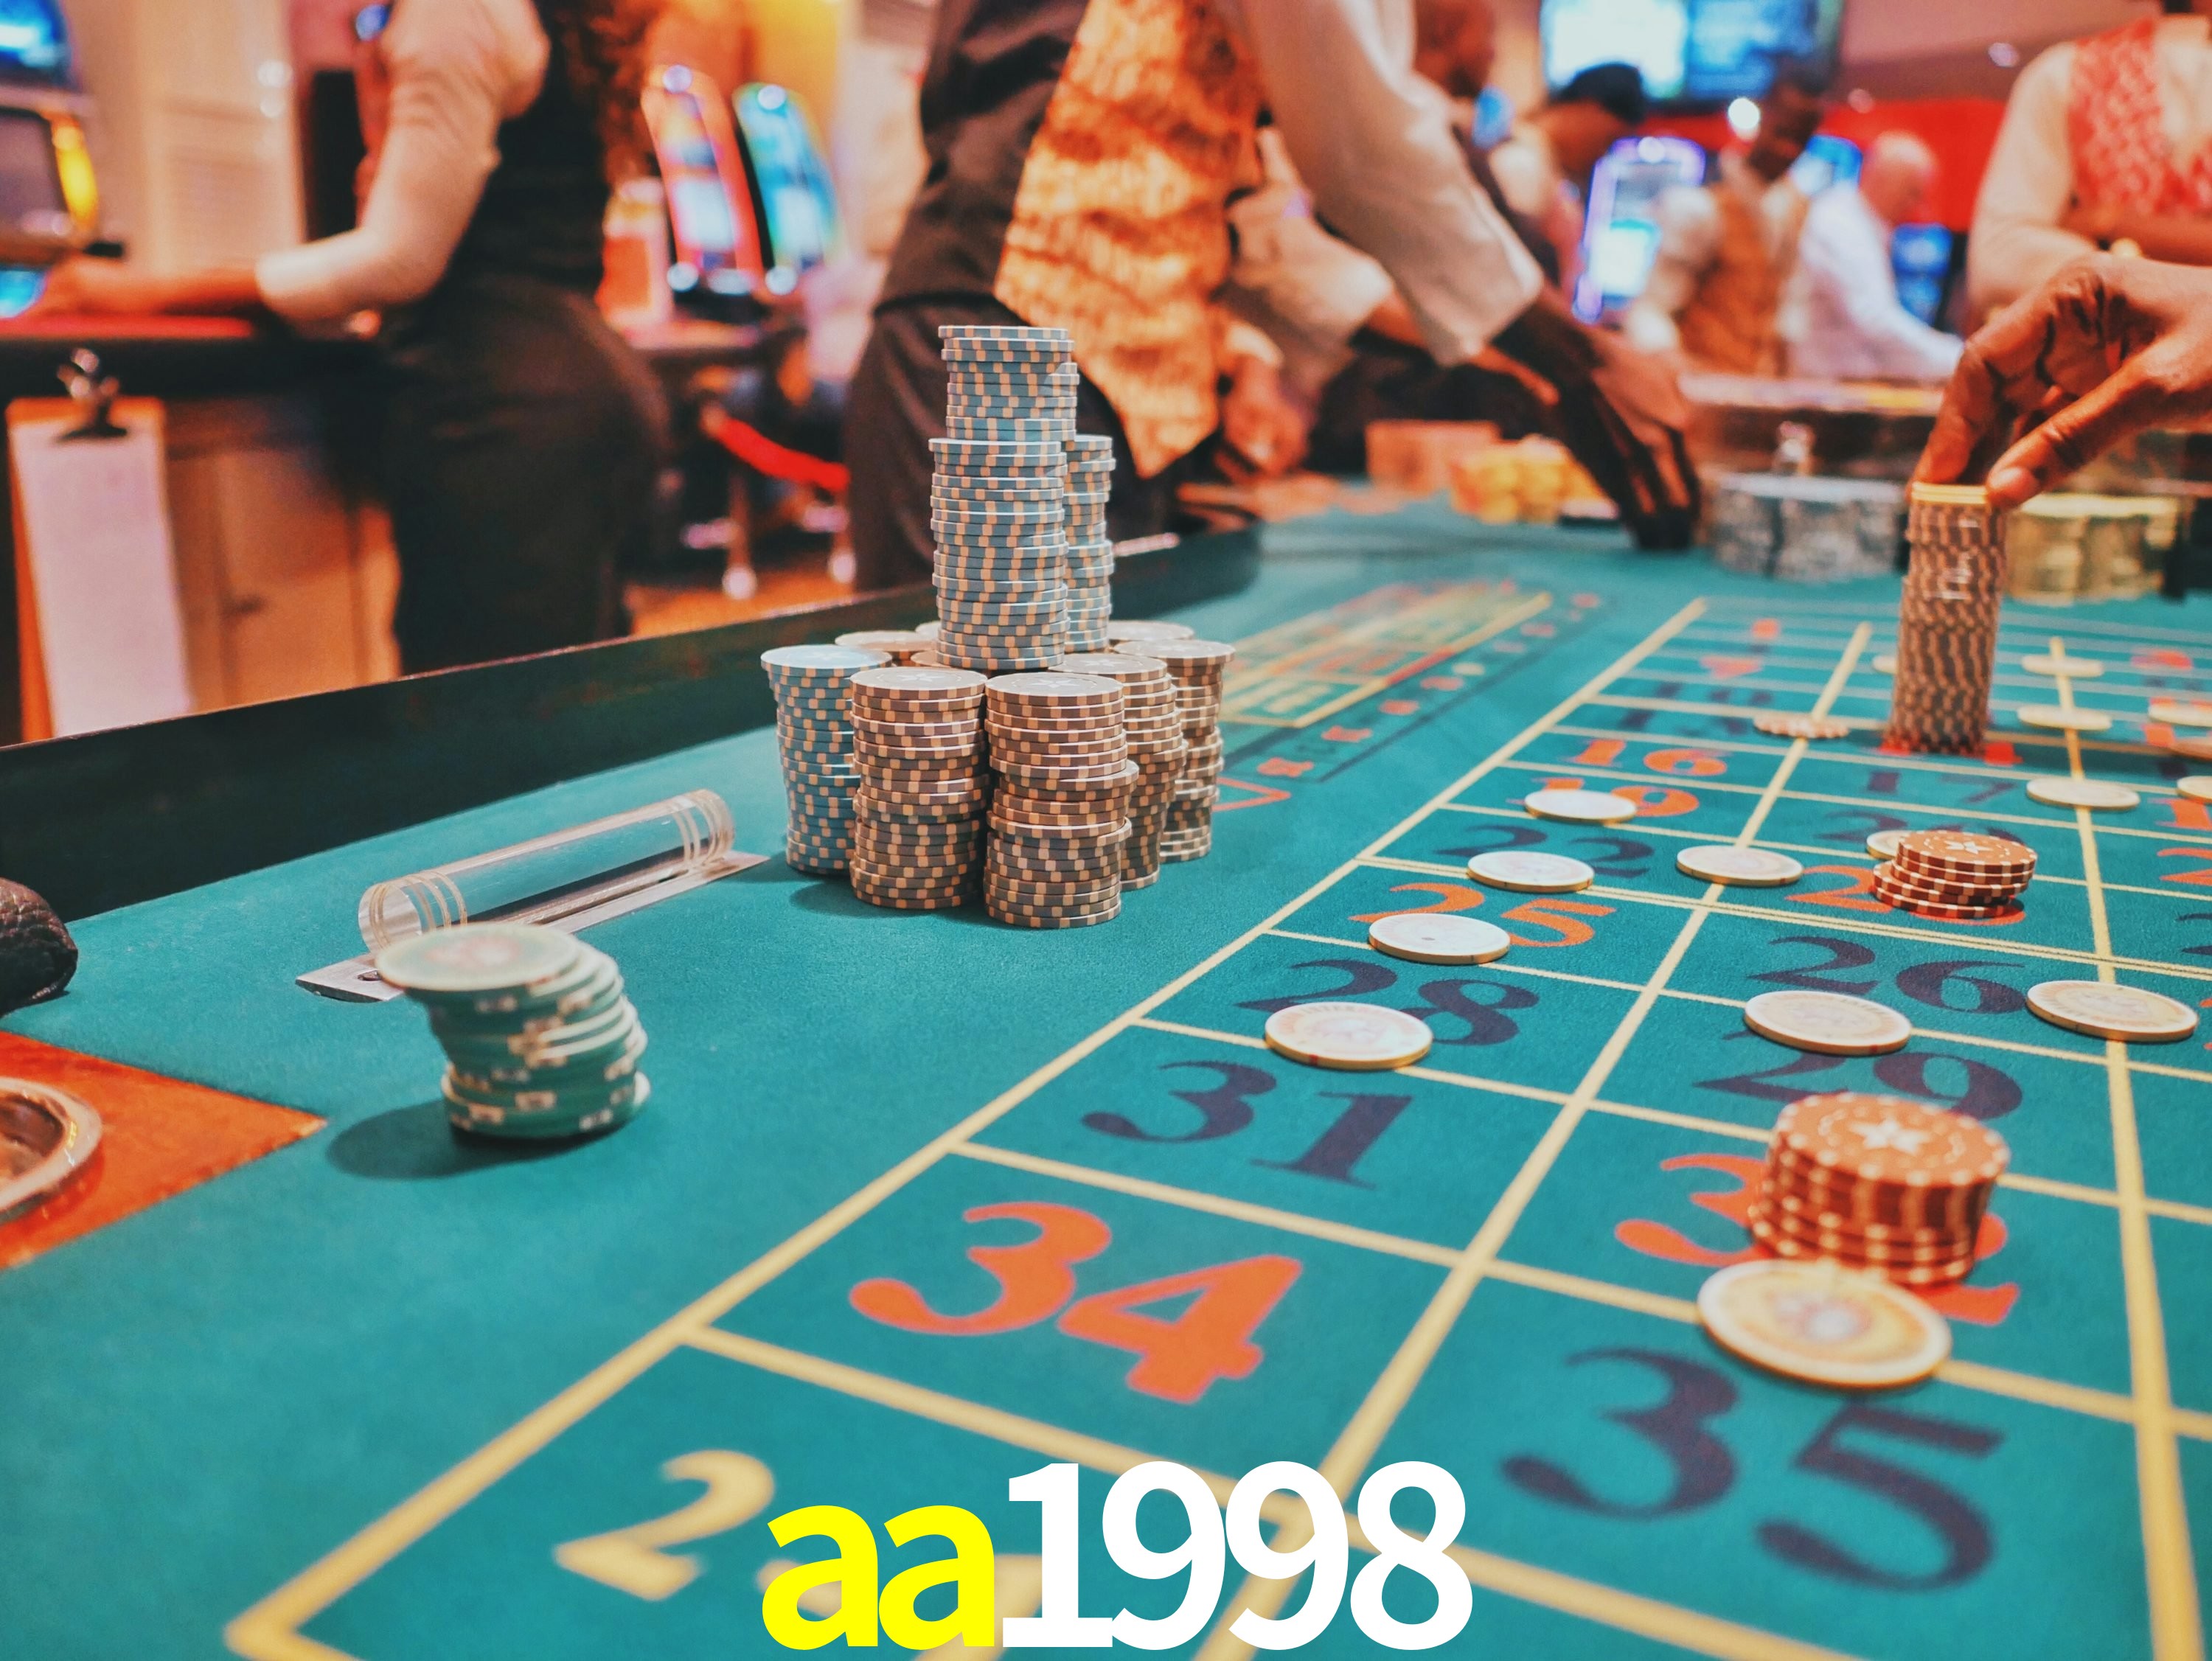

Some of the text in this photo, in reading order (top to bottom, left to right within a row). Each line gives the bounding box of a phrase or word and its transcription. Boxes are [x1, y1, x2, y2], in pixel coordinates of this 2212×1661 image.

[1558, 738, 1729, 776] 16
[1865, 770, 2018, 804] 17
[1433, 823, 1654, 878] 22
[1347, 882, 1617, 947] 25
[1783, 865, 2028, 926] 2
[1233, 958, 1540, 1045] 28
[1745, 934, 2028, 1014] 26
[1691, 1027, 2023, 1121] 29
[1080, 1059, 1413, 1191] 31
[848, 1200, 1304, 1405] 34
[1498, 1346, 2007, 1596] 35
